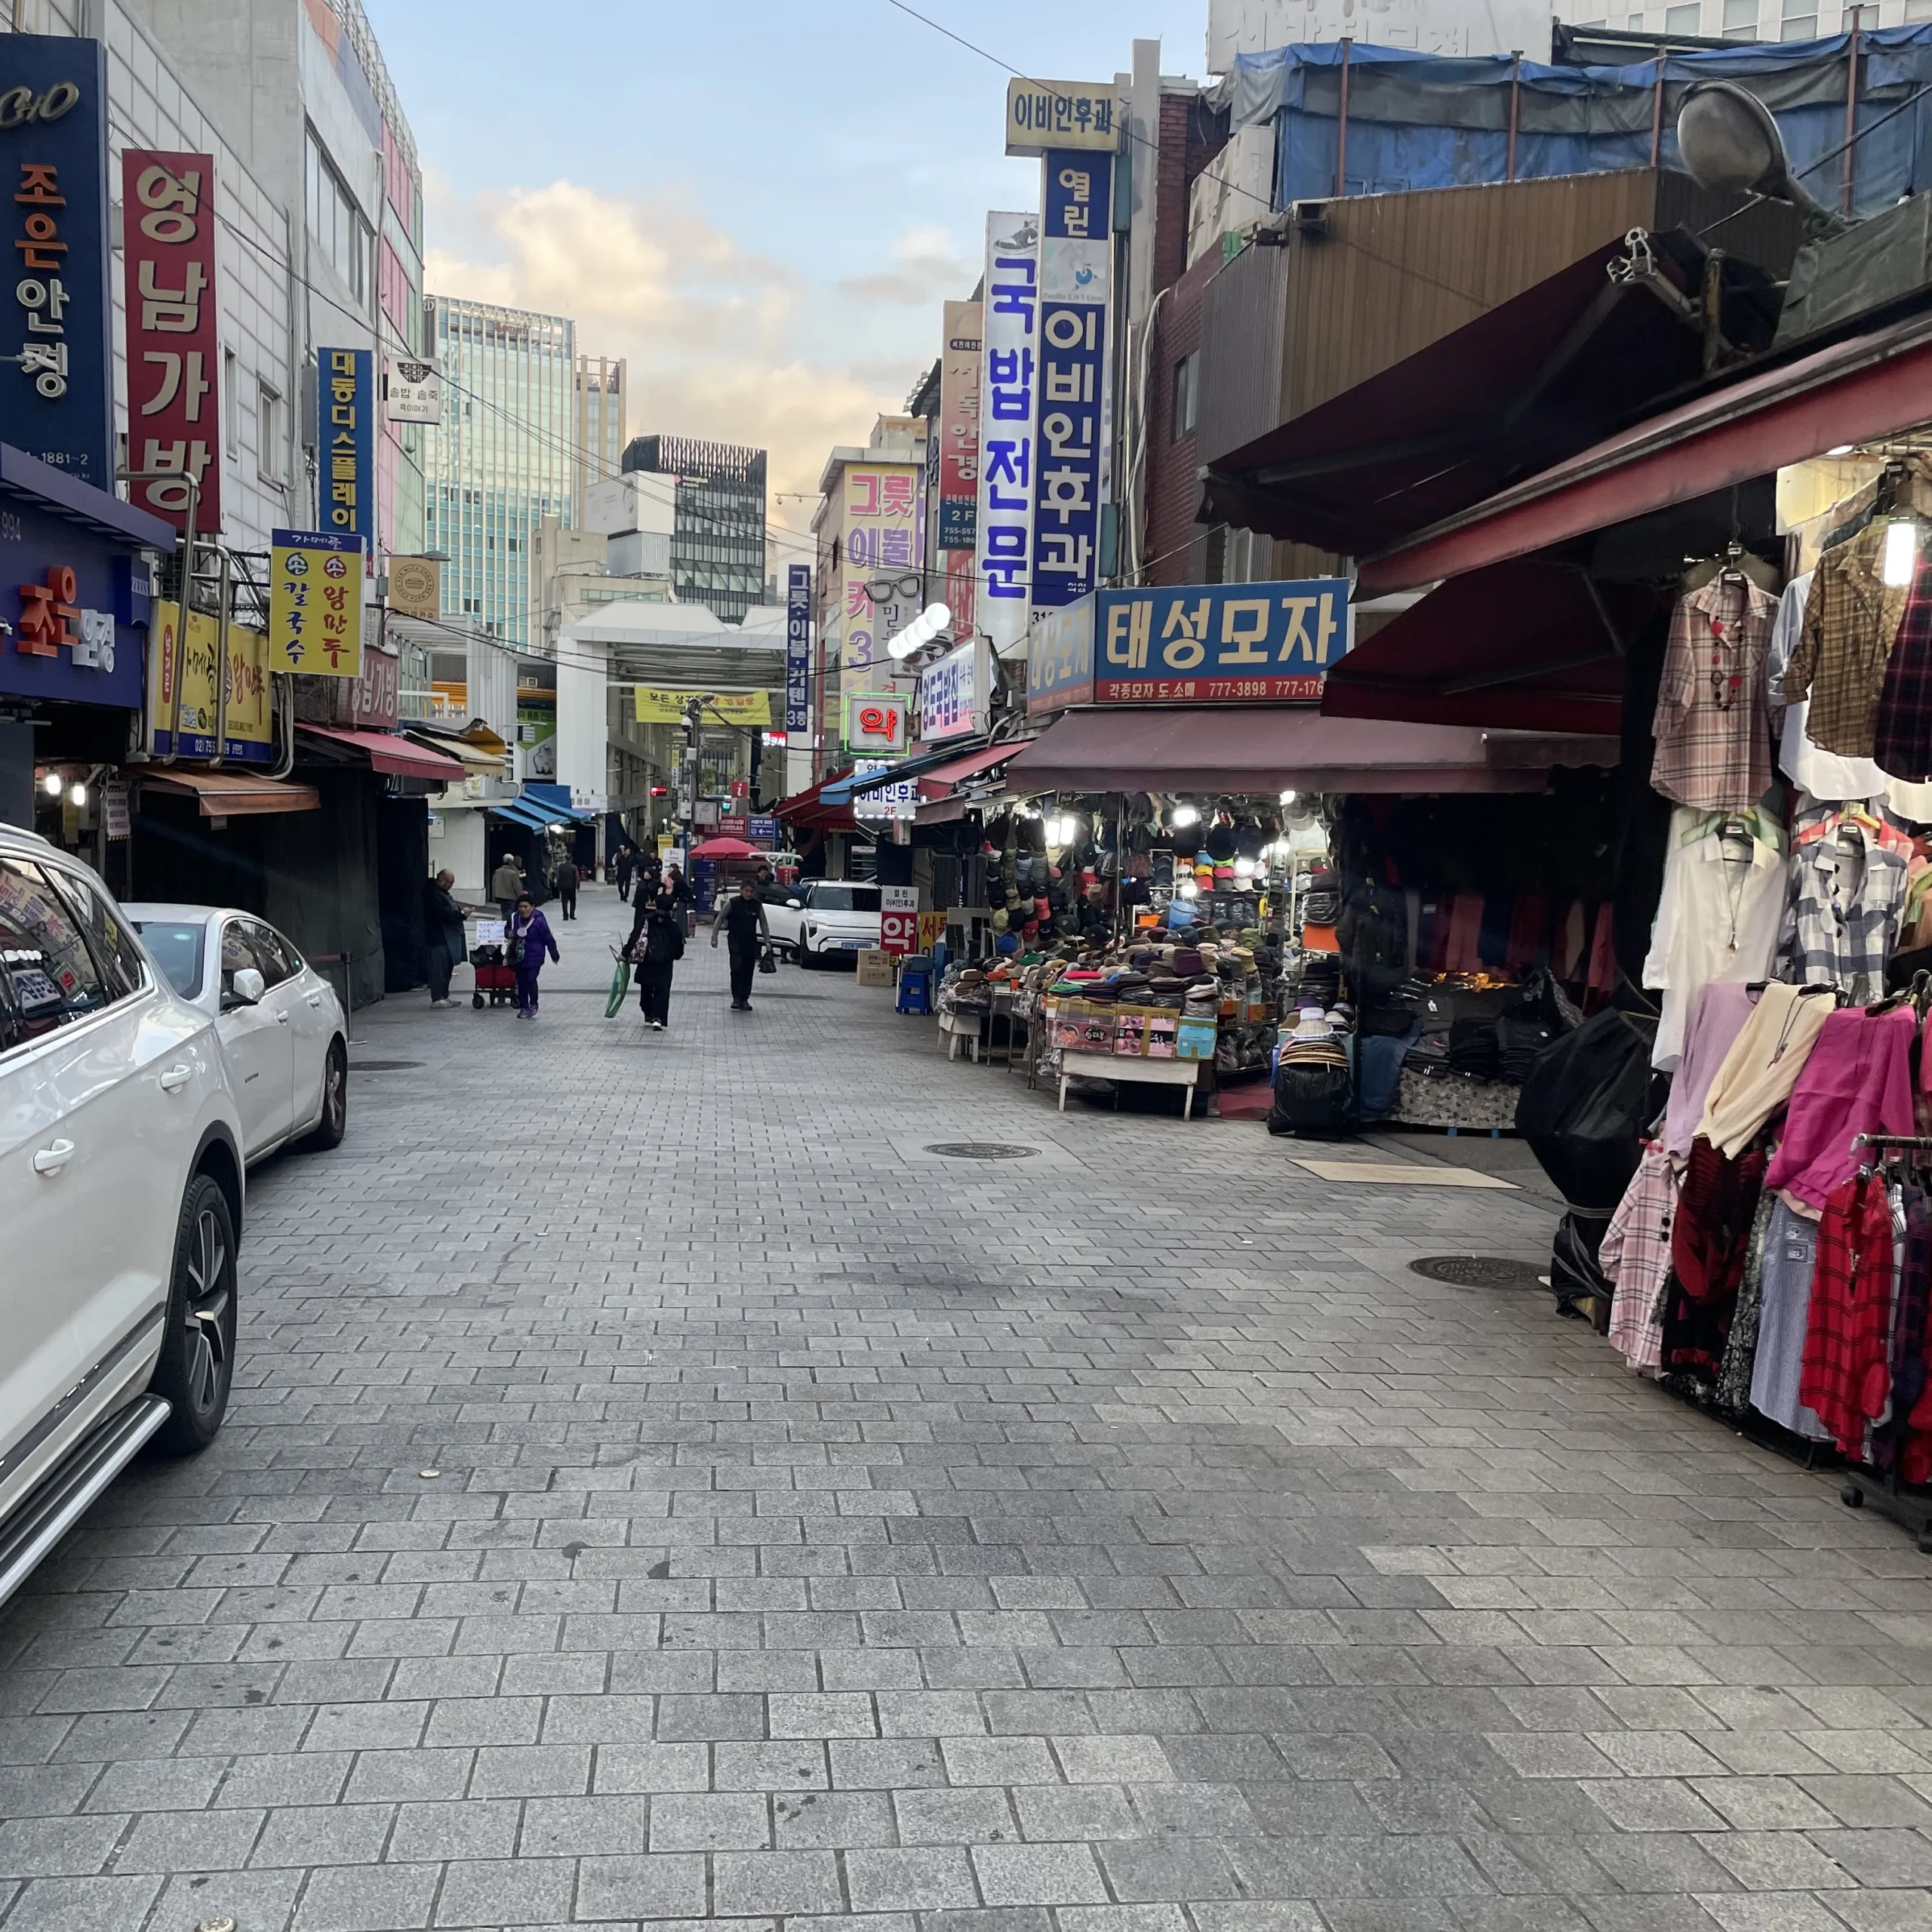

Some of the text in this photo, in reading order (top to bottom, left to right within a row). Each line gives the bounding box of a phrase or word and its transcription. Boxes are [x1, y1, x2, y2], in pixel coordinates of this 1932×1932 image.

[1014, 94, 1113, 134] 이비인후과
[1059, 168, 1091, 237] 열린
[14, 164, 70, 398] 조은안경
[137, 165, 211, 510] 영남가방
[400, 404, 428, 413] 죽이야기
[982, 257, 1037, 599] 국밥전문
[331, 352, 356, 532] 대동디스플레이
[1038, 309, 1097, 580] 이비인후과
[849, 474, 913, 517] 그릇
[847, 528, 912, 571] 이불
[944, 527, 976, 535] 755-557
[131, 576, 149, 596] ZEISS
[847, 580, 874, 622] 커
[1106, 592, 1337, 669] 태성모자
[1109, 682, 1155, 699] 각종모자
[1208, 681, 1267, 697] 777-3898
[1275, 680, 1324, 696] 777-176
[786, 709, 807, 726] 3층
[860, 708, 898, 743] 약
[884, 806, 897, 817] 2F
[885, 899, 915, 908] 이비인후과
[882, 916, 915, 951] 약
